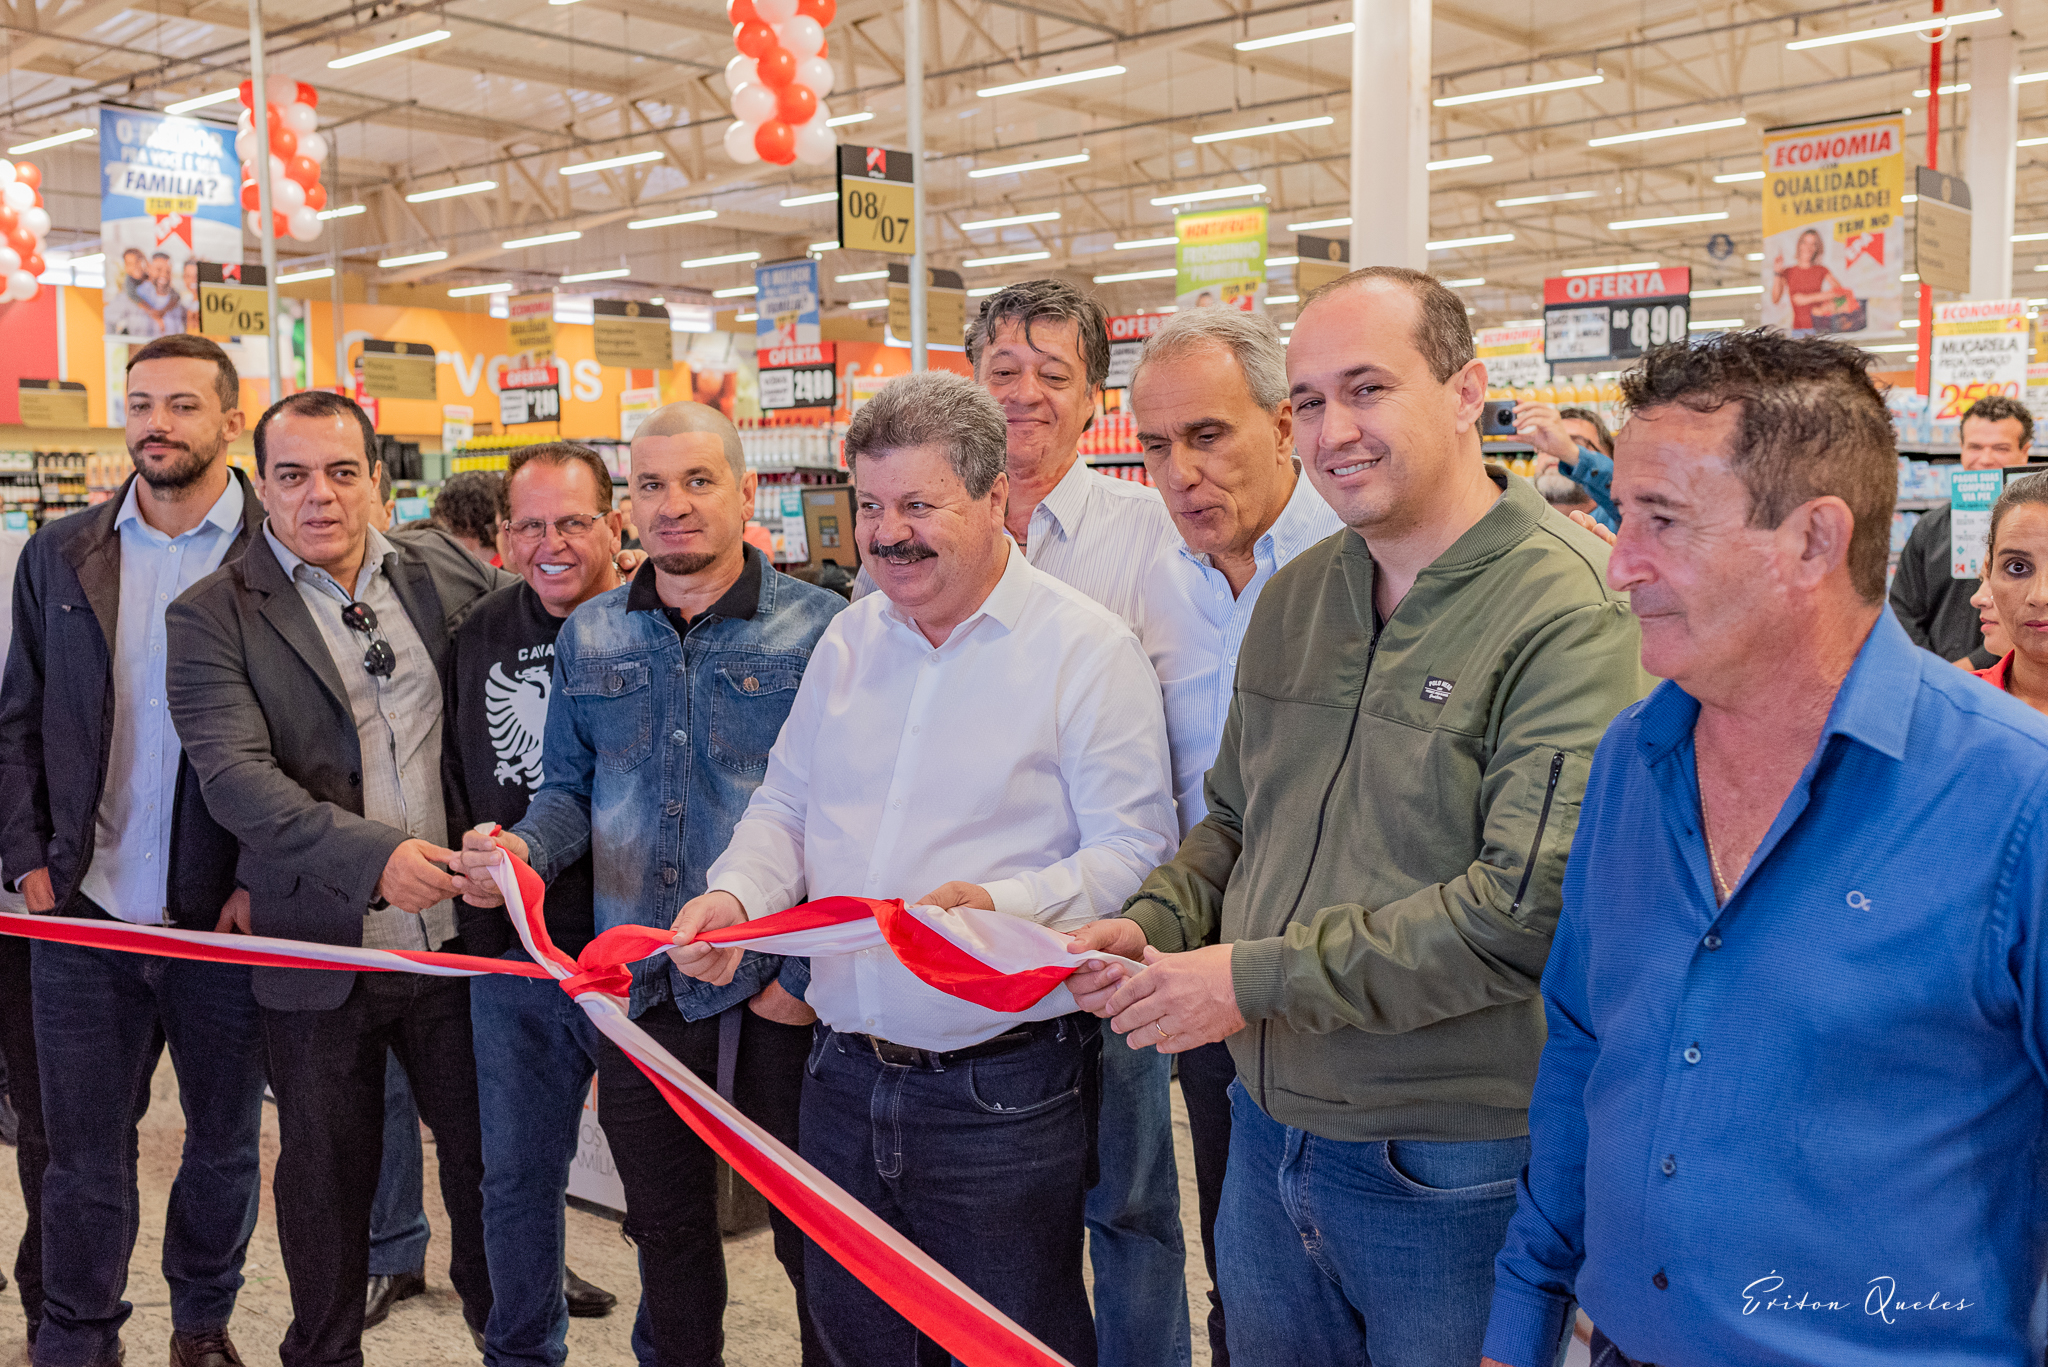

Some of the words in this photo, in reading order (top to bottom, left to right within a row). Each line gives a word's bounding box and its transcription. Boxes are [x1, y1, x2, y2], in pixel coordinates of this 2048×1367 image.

[1775, 131, 1891, 167] ECONOMIA
[1773, 166, 1878, 198] QUALIDADE
[1838, 219, 1864, 234] TEM
[1871, 213, 1890, 228] NO
[1566, 271, 1666, 299] OFERTA
[1612, 309, 1630, 329] R$
[1943, 302, 2021, 320] ECONOMIA
[768, 346, 823, 362] OFERTA
[1957, 482, 1996, 493] COMPRAS
[1961, 492, 1977, 502] VIA
[1977, 492, 1992, 502] PIX
